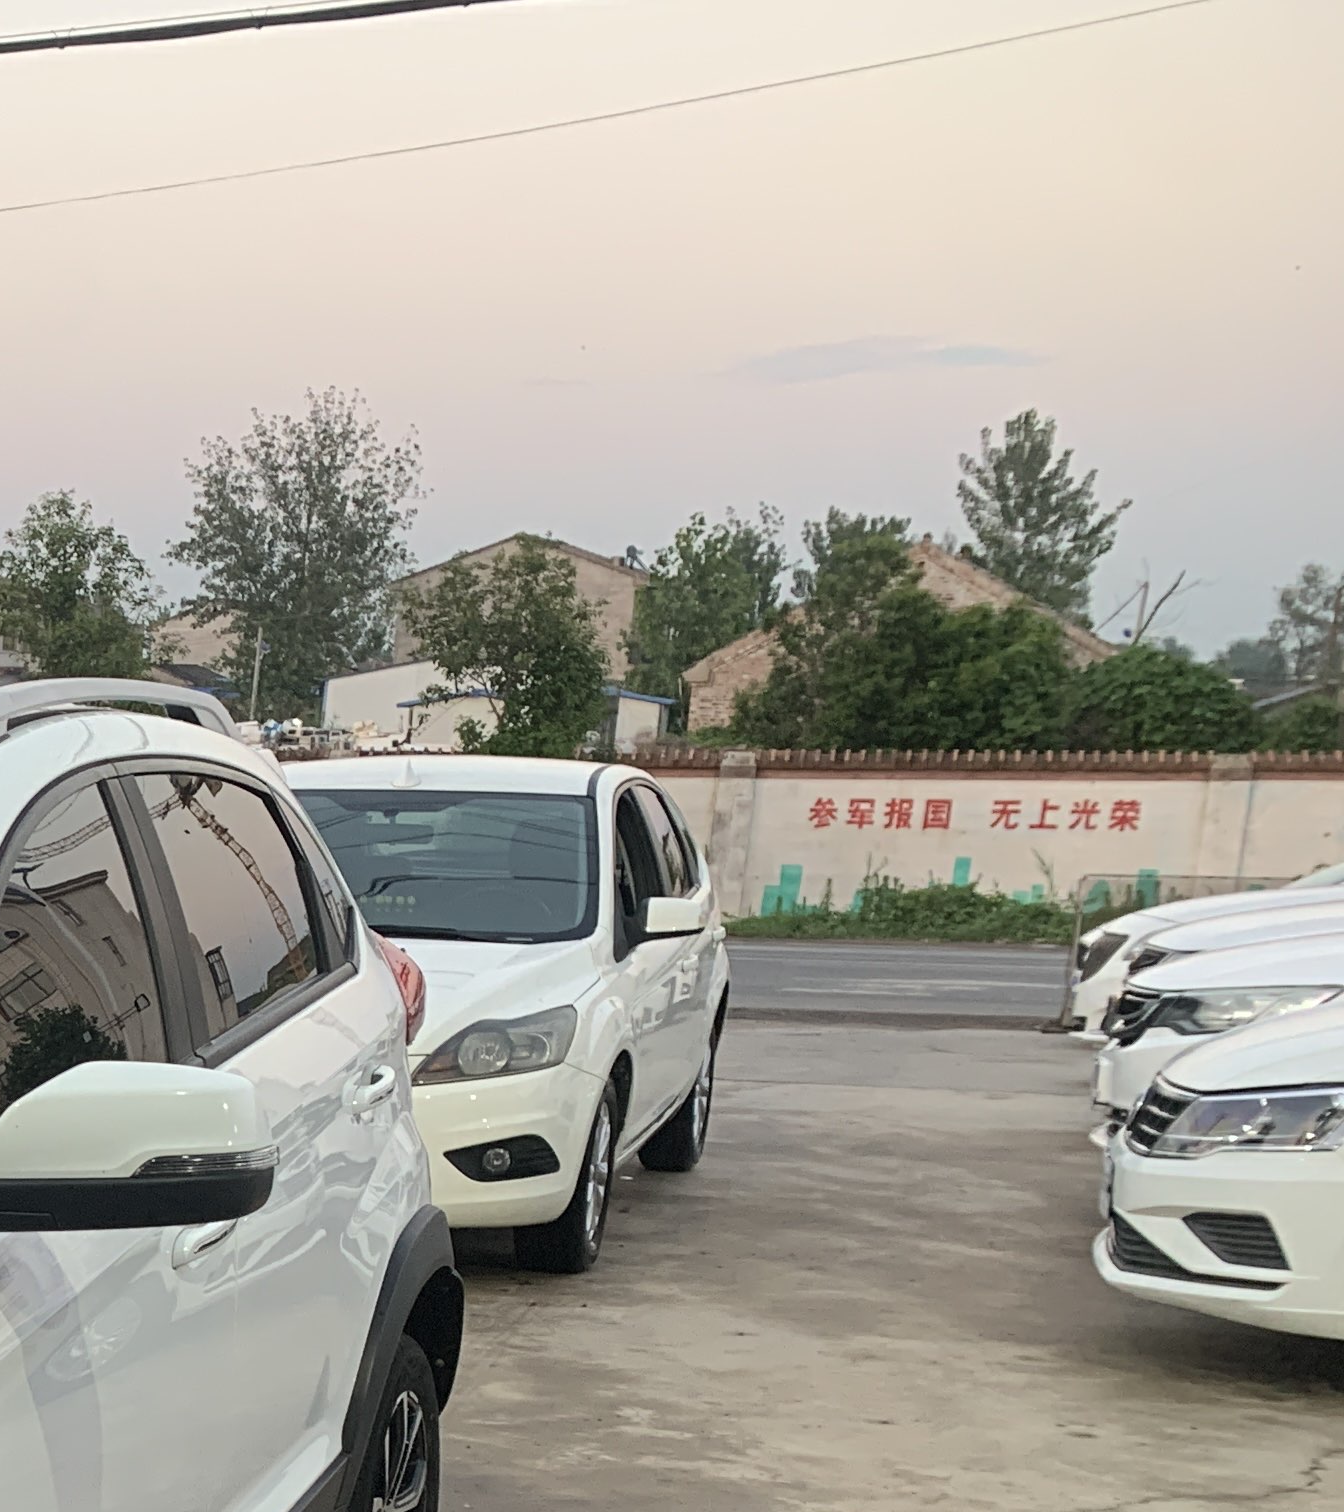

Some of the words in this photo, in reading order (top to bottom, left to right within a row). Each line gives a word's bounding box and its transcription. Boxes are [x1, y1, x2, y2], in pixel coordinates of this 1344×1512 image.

[808, 797, 953, 830] 参军报国
[990, 799, 1143, 832] 无上光荣
